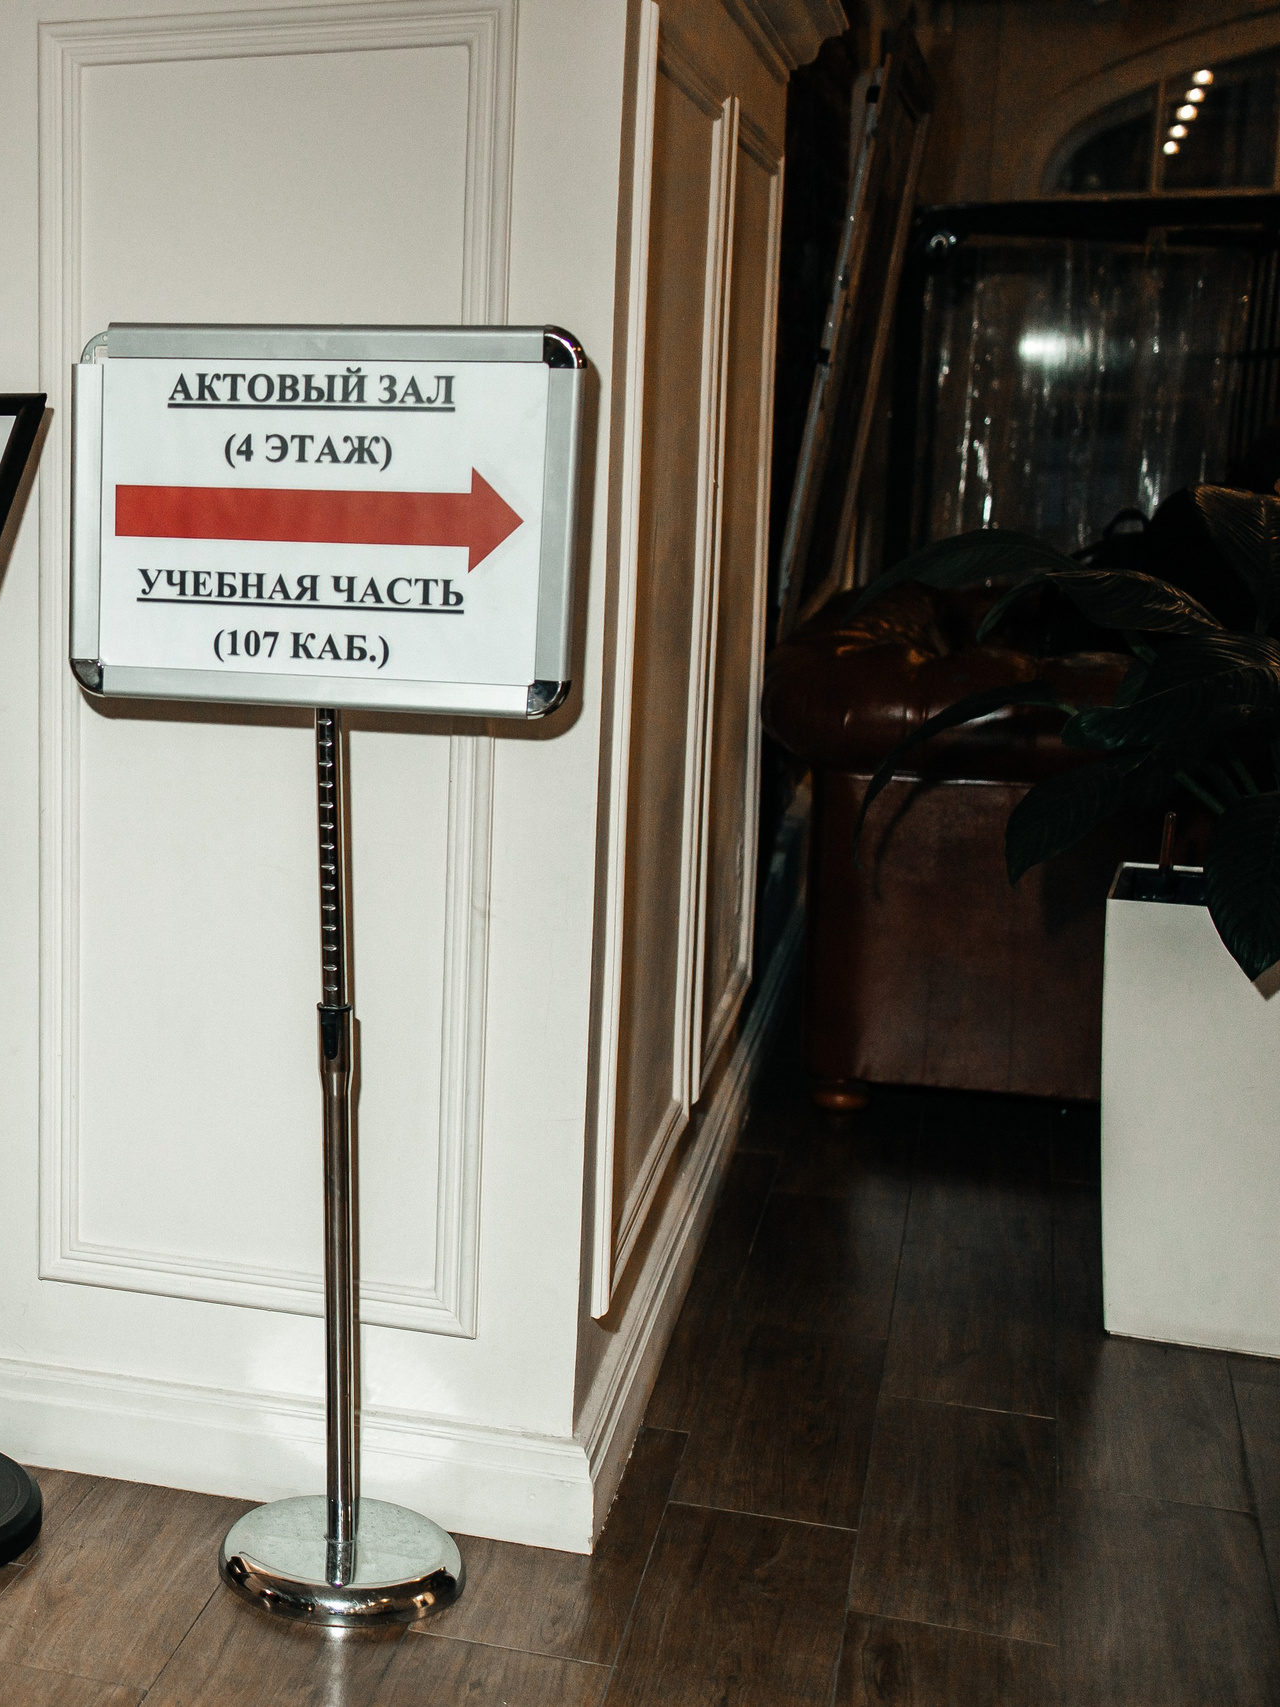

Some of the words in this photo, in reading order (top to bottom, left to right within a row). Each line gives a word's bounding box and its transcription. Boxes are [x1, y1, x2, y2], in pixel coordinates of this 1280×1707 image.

[168, 367, 368, 405] АКТОВЫЙ
[378, 374, 456, 406] ЗАЛ
[224, 433, 254, 469] (4
[265, 434, 393, 472] ЭТАЖ)
[138, 568, 320, 602] УЧЕБНАЯ
[331, 576, 465, 607] ЧАСТЬ
[212, 629, 280, 662] (107
[290, 632, 390, 668] КАБ.)
